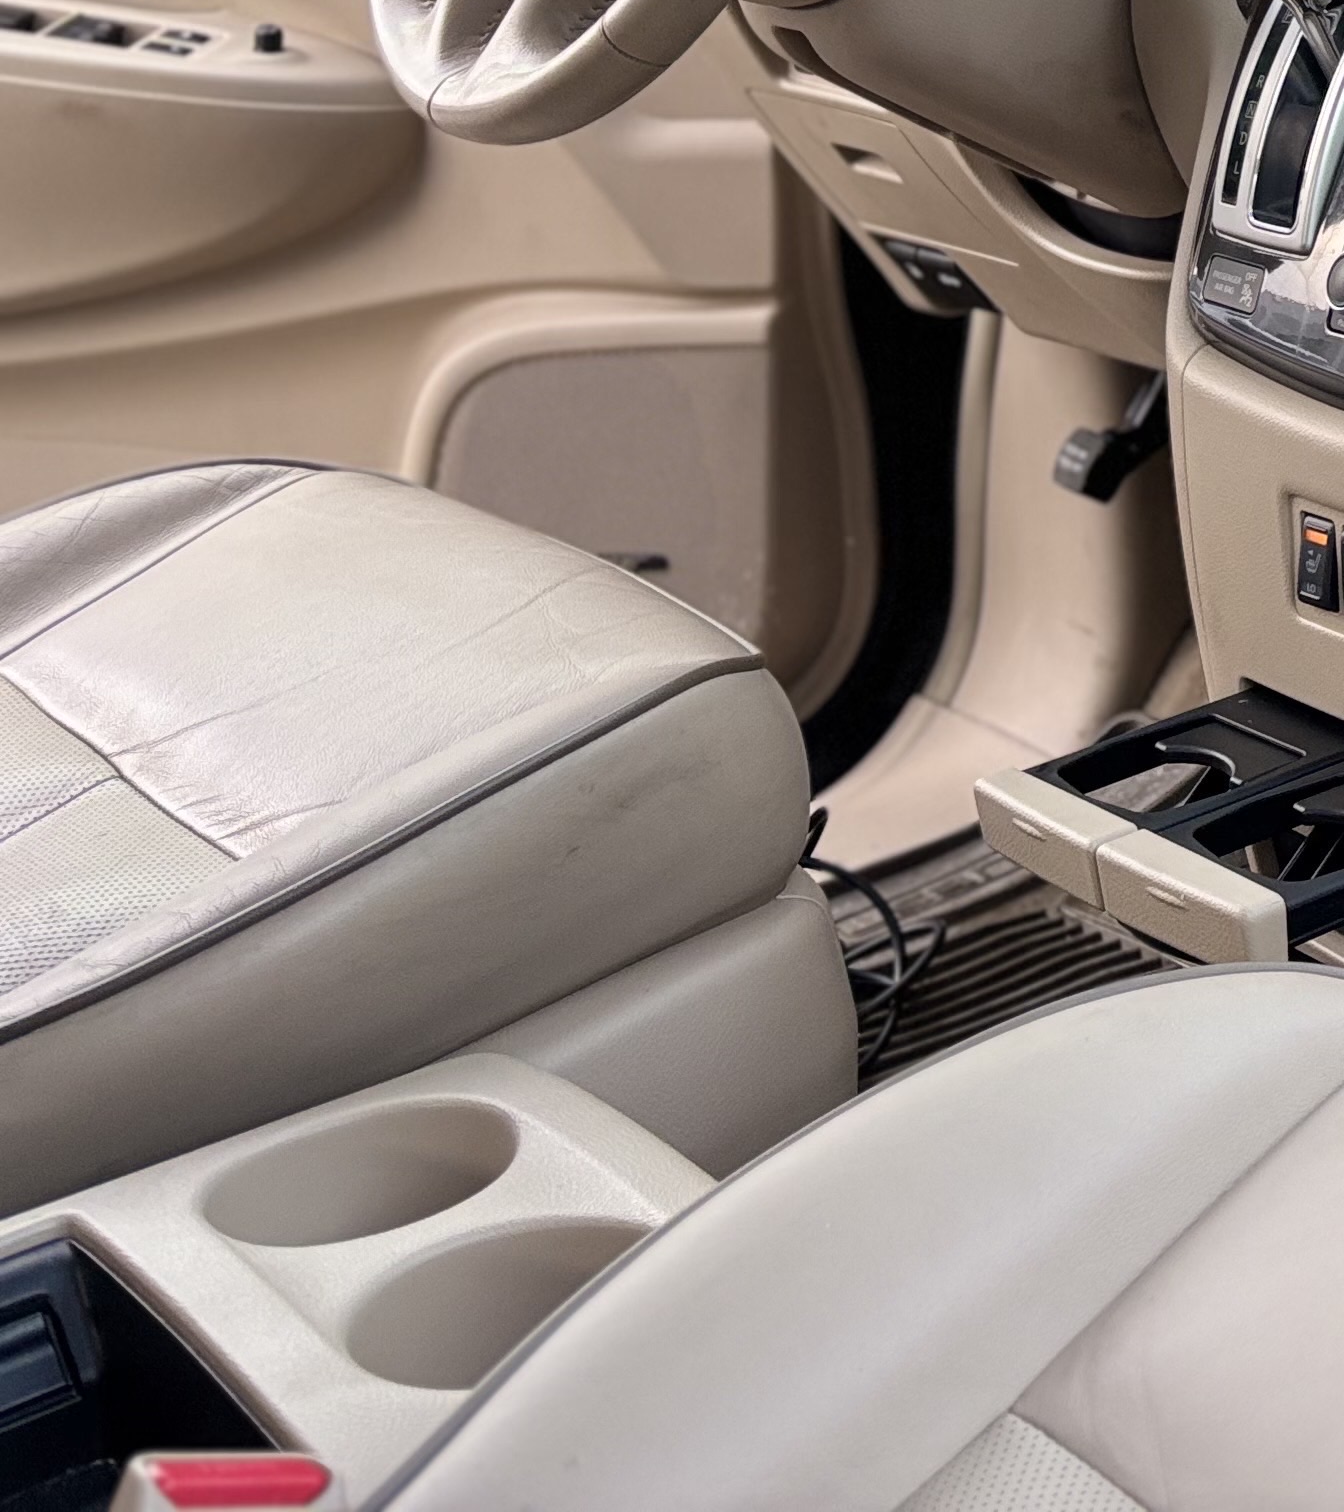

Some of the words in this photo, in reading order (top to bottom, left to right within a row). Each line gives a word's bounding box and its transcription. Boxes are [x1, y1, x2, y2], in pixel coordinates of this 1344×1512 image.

[1256, 74, 1266, 88] R
[1239, 131, 1248, 146] D
[1232, 160, 1240, 175] L
